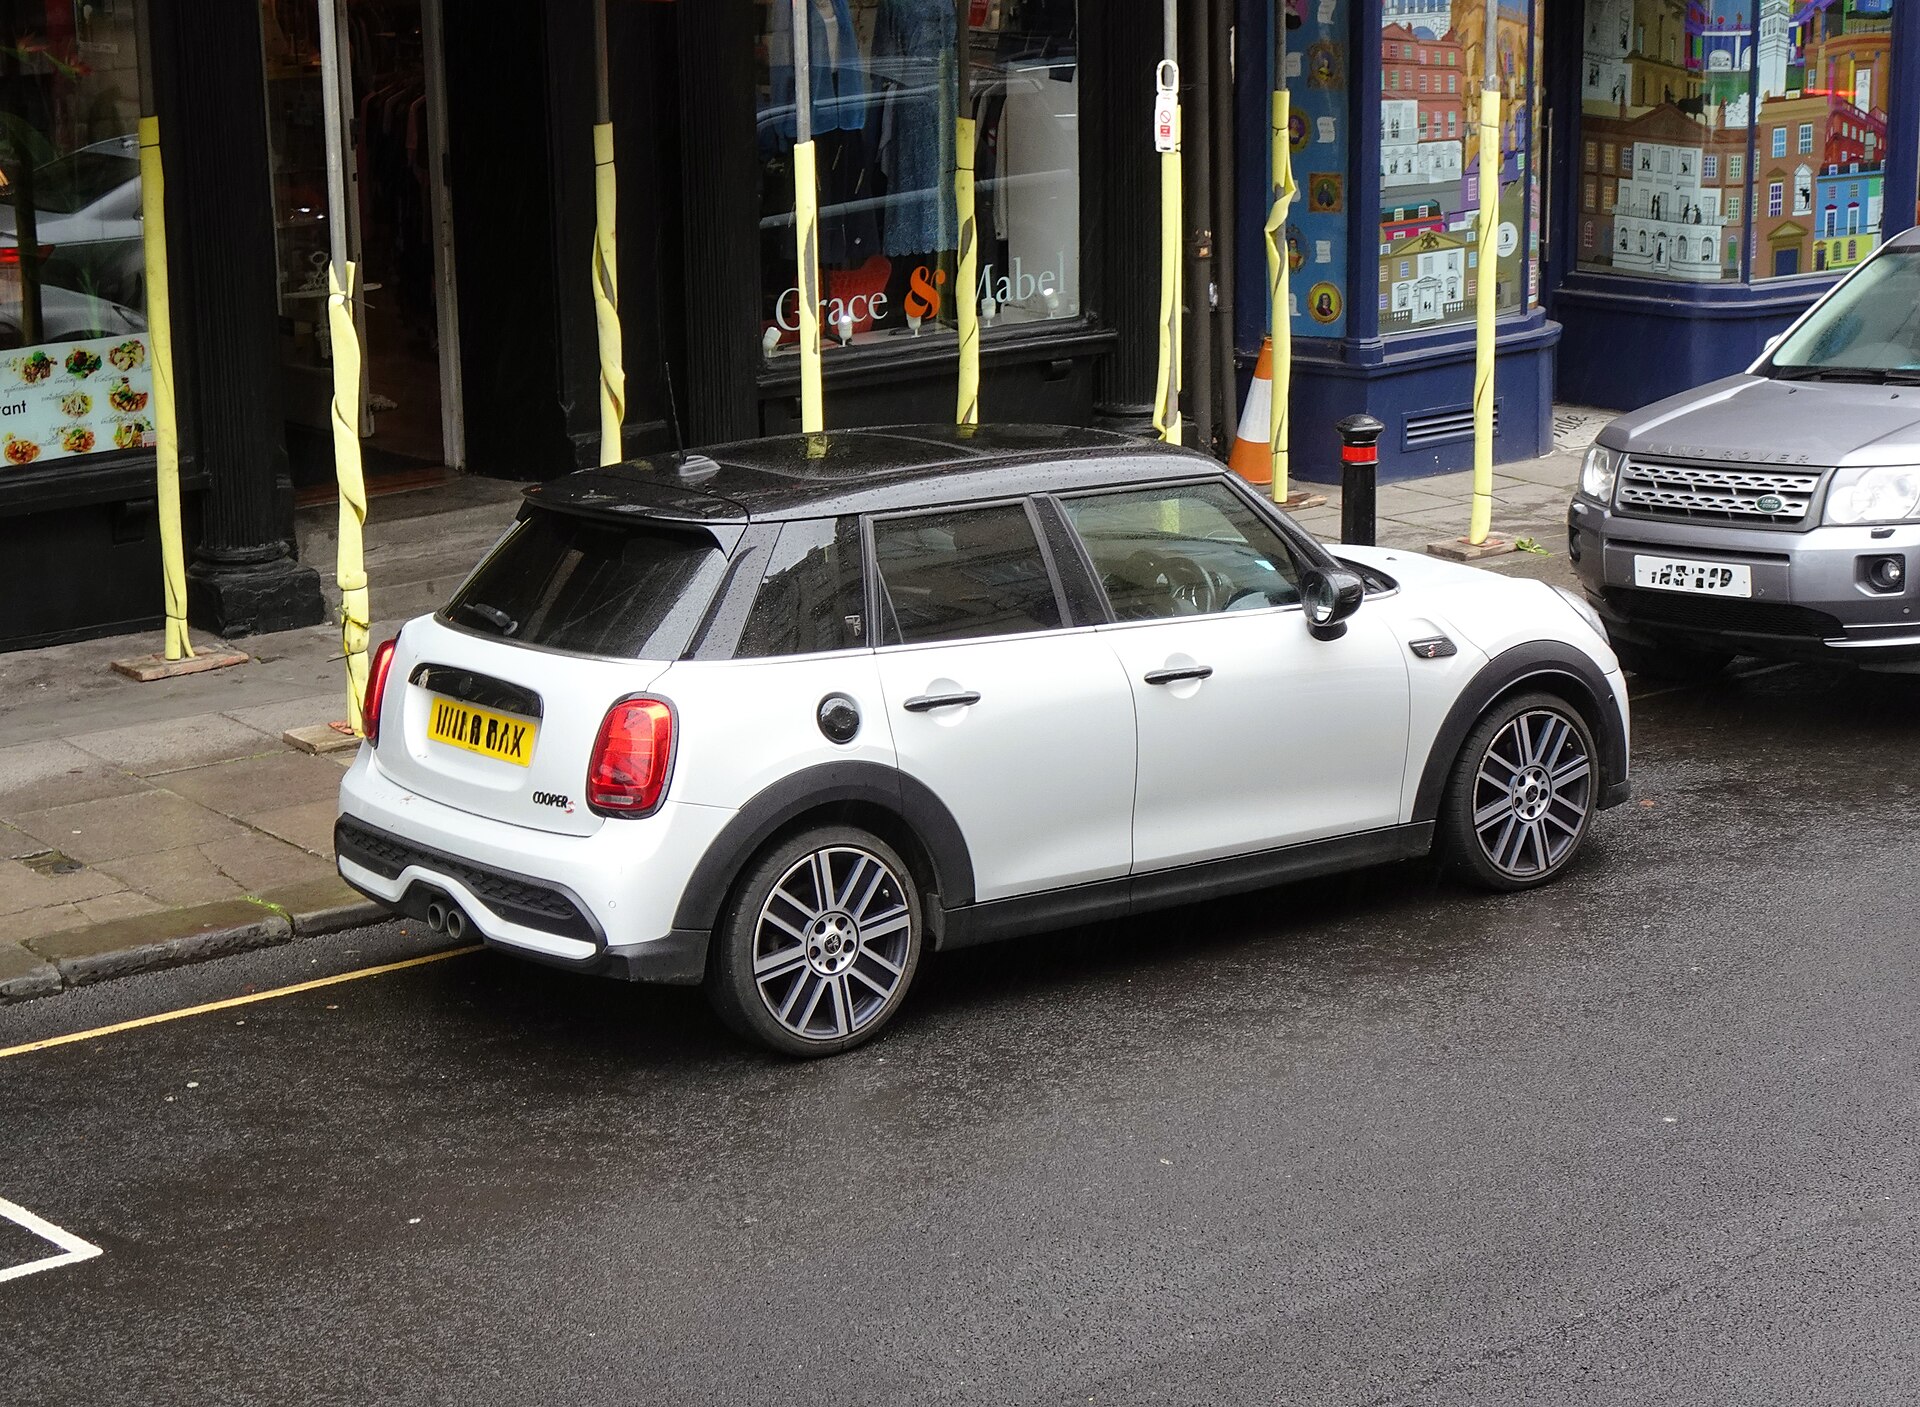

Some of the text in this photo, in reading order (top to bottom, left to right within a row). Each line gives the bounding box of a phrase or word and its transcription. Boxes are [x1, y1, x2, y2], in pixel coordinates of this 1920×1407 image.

[904, 266, 946, 319] &
[0, 400, 27, 416] ant
[1719, 448, 1809, 464] ROVER
[532, 791, 569, 809] COOPER
